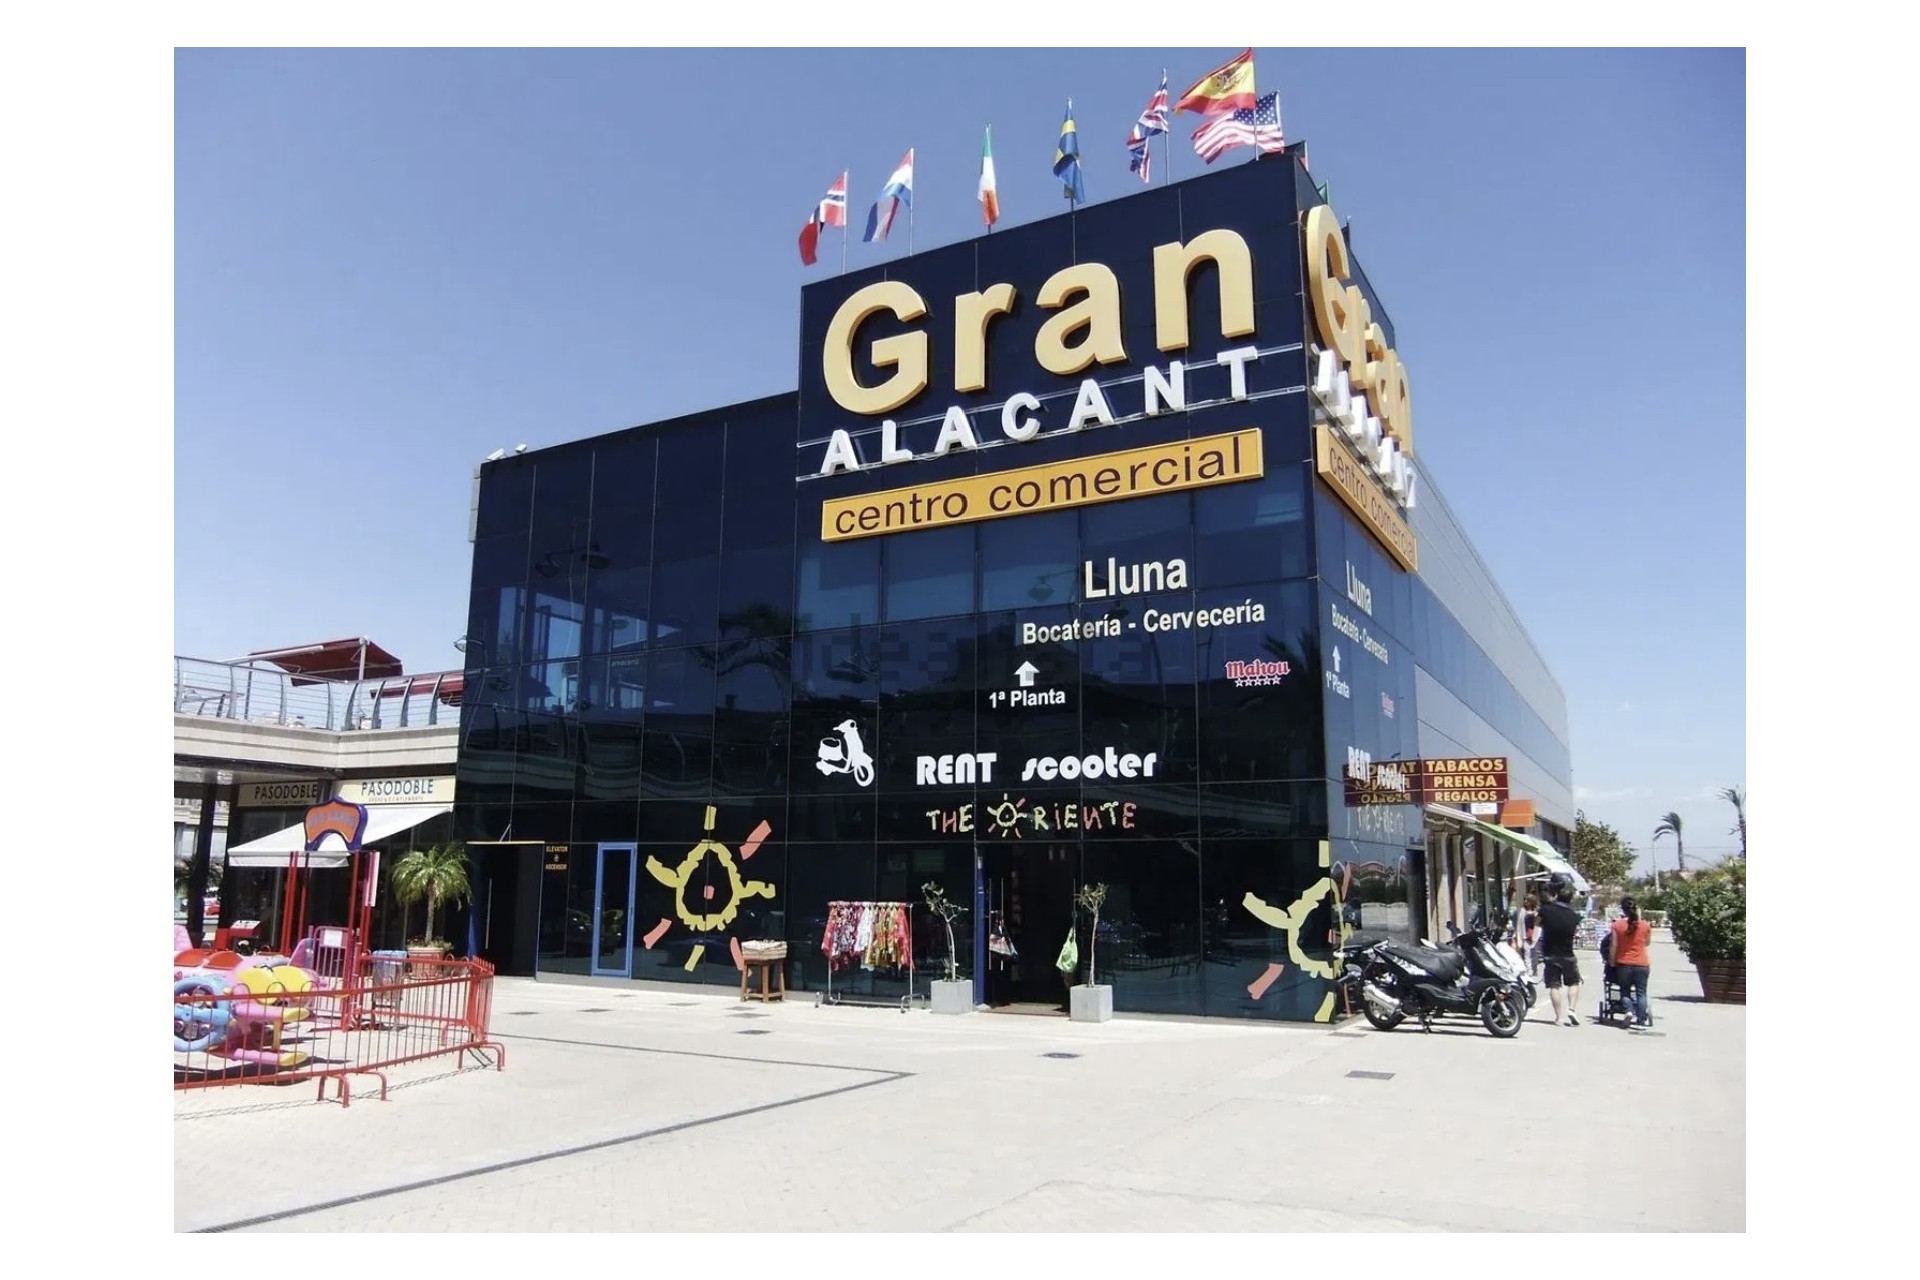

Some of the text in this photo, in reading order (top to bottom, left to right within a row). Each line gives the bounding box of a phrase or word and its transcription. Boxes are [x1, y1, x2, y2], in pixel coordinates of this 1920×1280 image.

[823, 229, 1256, 415] Gran
[820, 346, 1259, 474] ALACANT
[834, 437, 1242, 535] centro comercial
[1328, 447, 1368, 510] centro
[1084, 558, 1188, 599] Lluna
[1346, 560, 1372, 616] Lluna
[1022, 614, 1122, 646] Bocatería
[1143, 599, 1266, 633] Cervecería
[1225, 658, 1291, 679] Mahou
[988, 688, 1066, 708] 1ª Planta
[1332, 674, 1350, 699] Planta
[916, 746, 1157, 785] RENT scooter
[1426, 758, 1504, 773] TABACOS
[254, 784, 318, 799] PASODOBLE
[361, 778, 434, 796] PASODOBLE
[1433, 774, 1497, 788] PRENSA
[1434, 790, 1498, 802] REGALOS
[926, 803, 974, 833] THE
